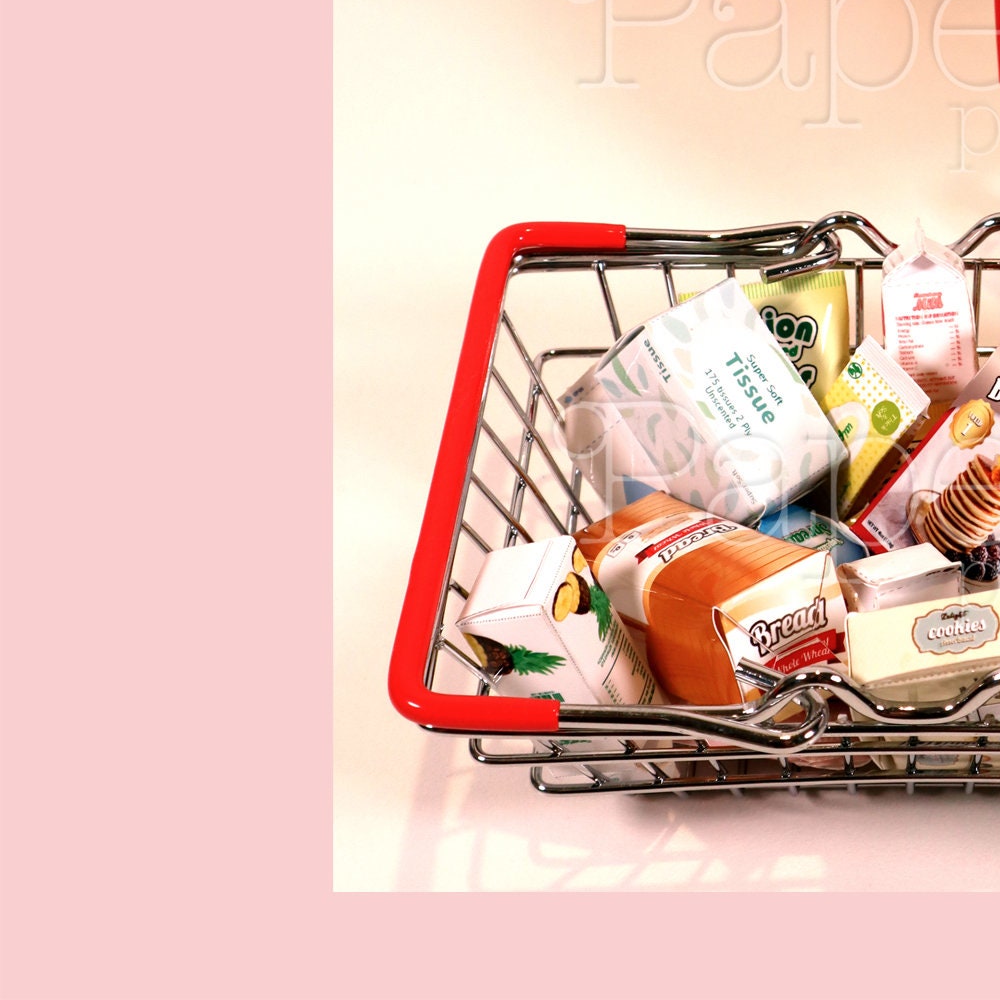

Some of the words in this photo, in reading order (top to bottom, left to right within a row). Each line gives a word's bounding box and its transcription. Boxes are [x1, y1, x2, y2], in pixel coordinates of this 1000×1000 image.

[764, 310, 814, 343] ion
[643, 338, 672, 384] Tissue
[746, 354, 769, 383] Super
[766, 384, 784, 407] Soft
[704, 368, 720, 386] 175
[716, 386, 738, 415] tissues
[735, 414, 745, 422] 2
[742, 422, 753, 437] Ply
[705, 385, 737, 429] Unscented
[725, 351, 776, 425] Tissue
[658, 523, 738, 563] Bread
[748, 596, 829, 658] Bread
[927, 619, 987, 641] cookies
